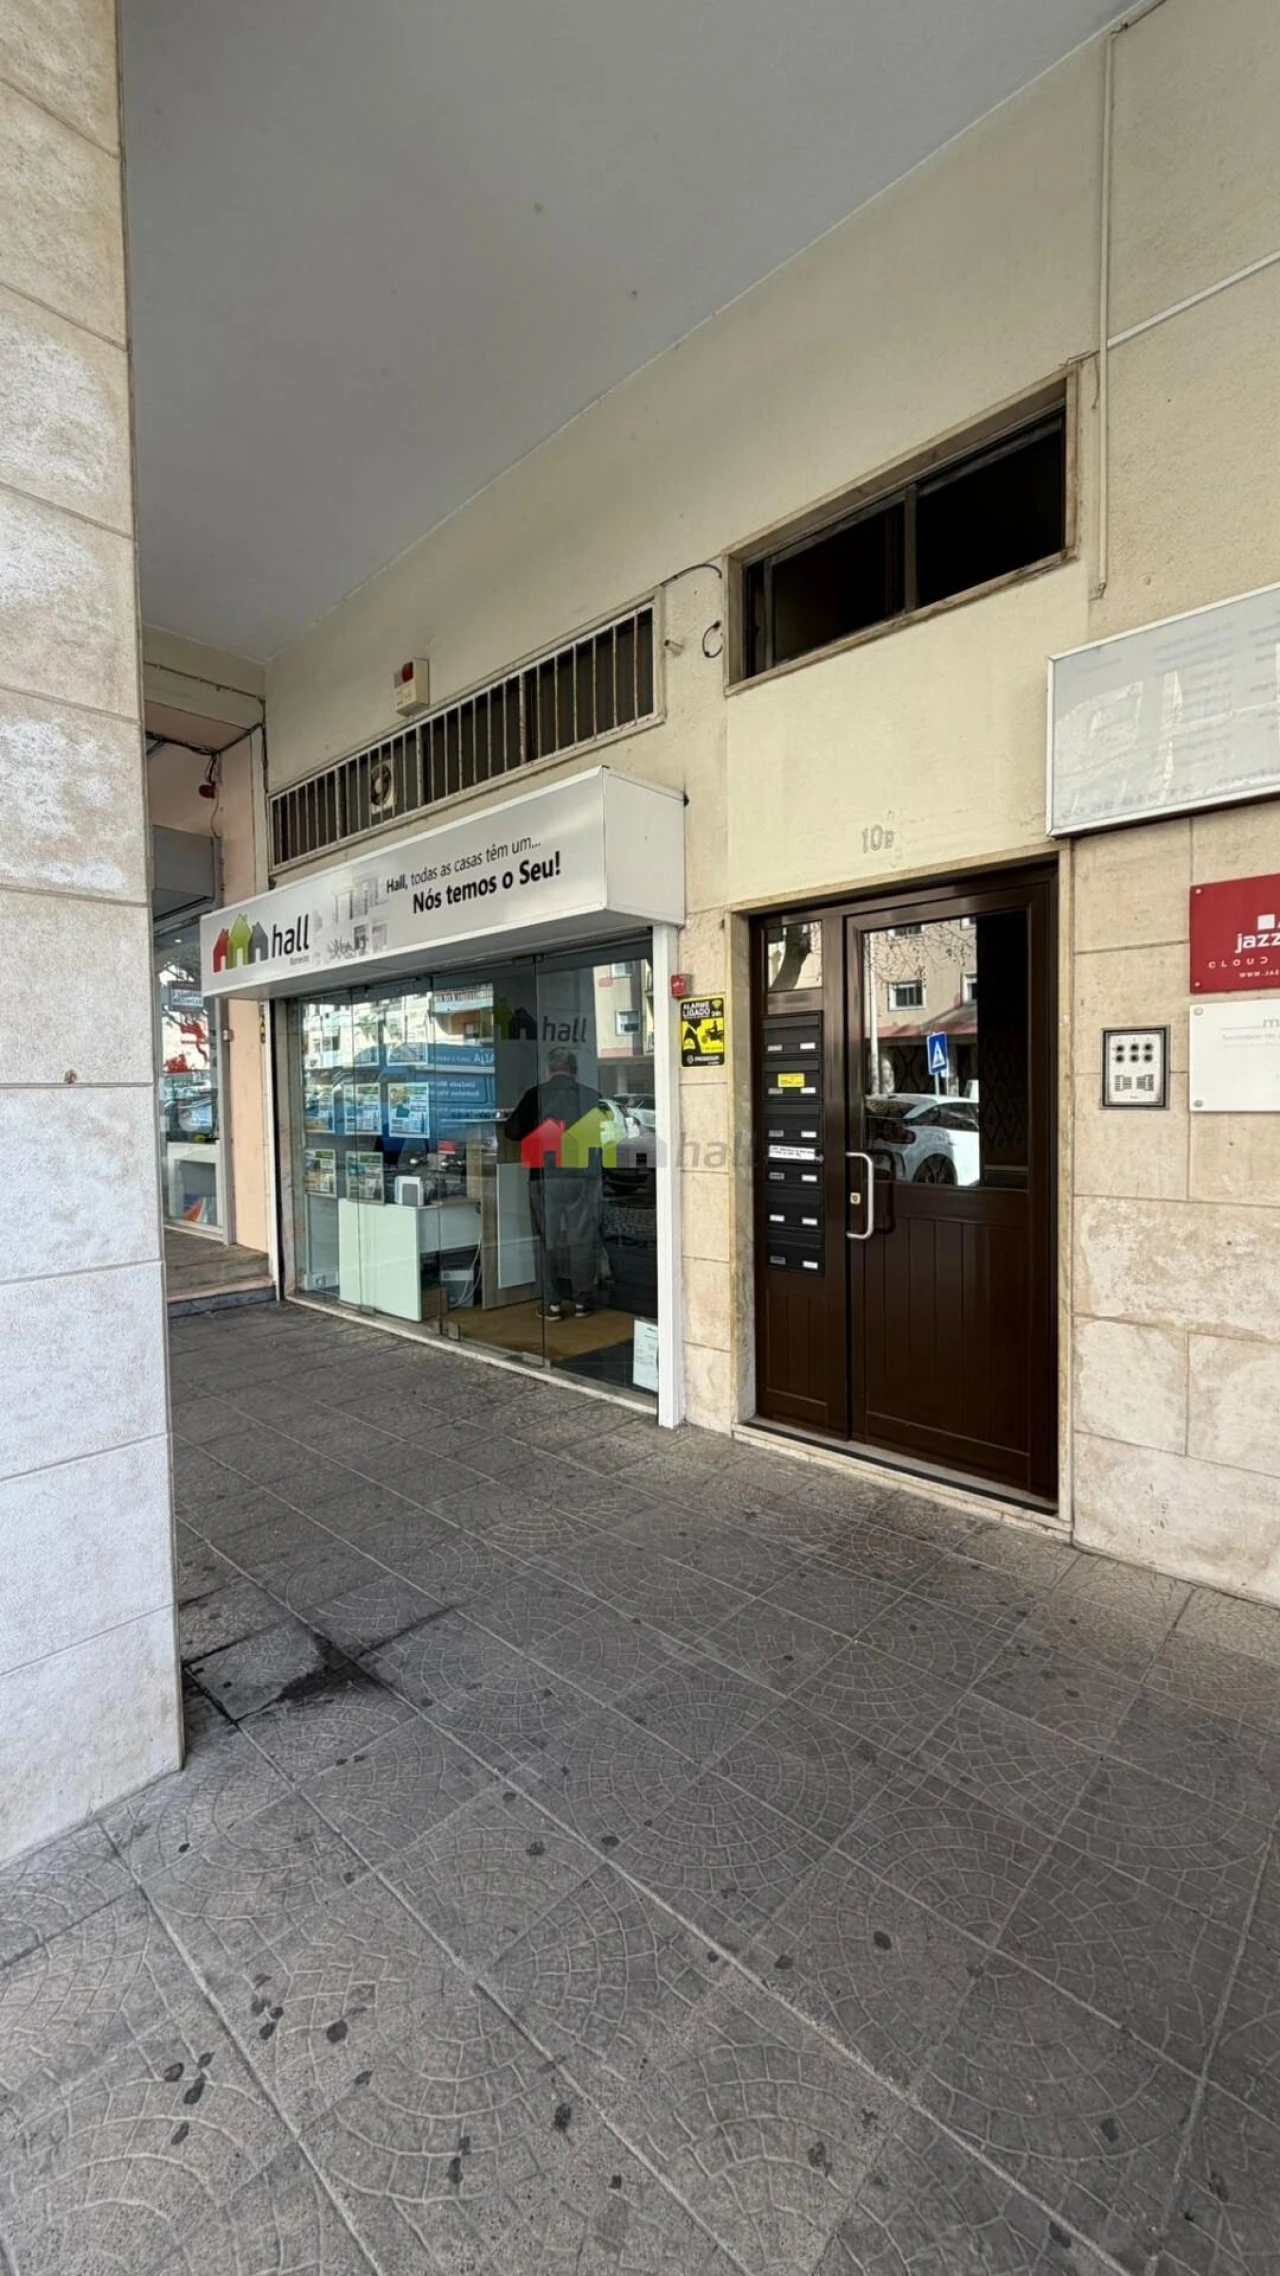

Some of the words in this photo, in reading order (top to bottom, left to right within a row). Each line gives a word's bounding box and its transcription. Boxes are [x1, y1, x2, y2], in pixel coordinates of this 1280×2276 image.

[386, 874, 409, 893] Hall,
[411, 866, 438, 886] todas
[440, 863, 452, 877] as
[454, 853, 483, 873] casas
[485, 844, 509, 863] têm
[511, 836, 541, 855] um...
[413, 888, 442, 914] Nós
[446, 875, 497, 905] temos
[502, 871, 514, 889] o
[519, 850, 561, 885] Seu!
[271, 913, 309, 958] hall
[1208, 956, 1269, 969] CLOUD
[542, 1015, 588, 1043] hall
[683, 1009, 711, 1017] LIGADO
